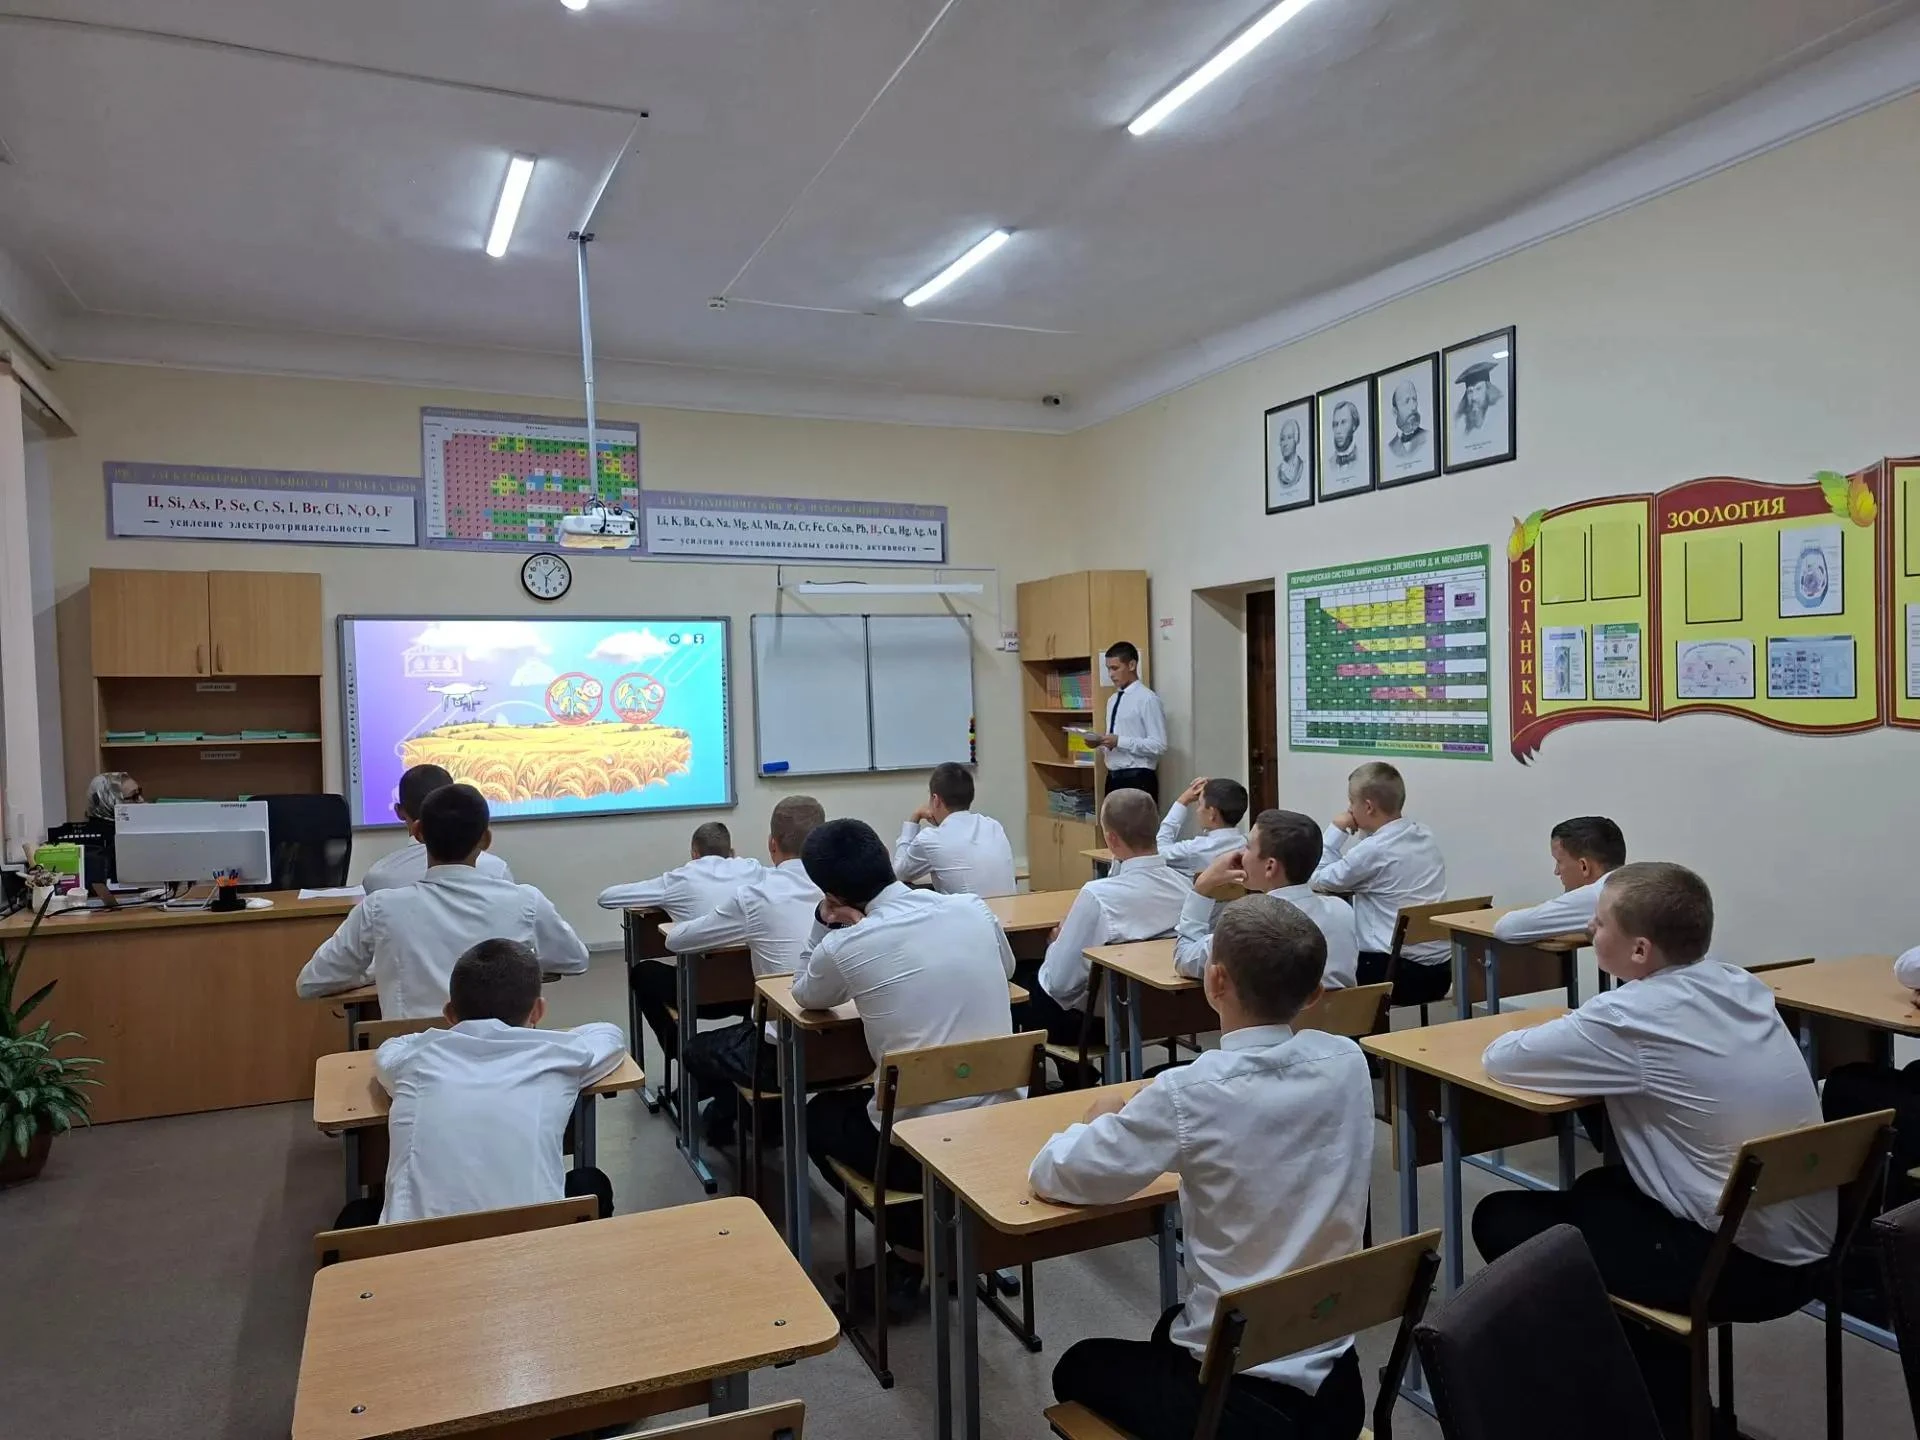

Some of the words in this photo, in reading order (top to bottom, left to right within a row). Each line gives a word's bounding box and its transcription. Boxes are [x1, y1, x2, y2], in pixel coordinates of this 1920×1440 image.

[148, 496, 163, 509] H,
[167, 496, 185, 510] Si,
[188, 498, 210, 511] As,
[215, 499, 226, 512] P,
[230, 500, 249, 512] Se,
[253, 500, 269, 513] C,
[272, 501, 285, 513] S,
[303, 502, 321, 515] Br,
[348, 504, 362, 517] N,
[365, 505, 380, 517] O,
[385, 506, 393, 517] F
[1667, 496, 1786, 529] ЗООЛОГИЯ
[169, 518, 223, 529] усиление
[230, 520, 370, 534] электроотрицательности
[657, 515, 669, 526] Li,
[671, 515, 681, 526] K,
[684, 516, 698, 528] Ba,
[700, 517, 714, 528] Ca,
[717, 518, 731, 528] Na,
[733, 518, 750, 531] Mg,
[765, 519, 780, 531] Mn,
[783, 520, 797, 532] Zn,
[798, 521, 811, 532] Cr,
[813, 522, 825, 533] Fe,
[856, 523, 868, 535] Pb,
[899, 525, 912, 537] Hg,
[680, 537, 724, 547] усиление
[729, 539, 820, 550] восстановительных
[866, 543, 916, 553] активности
[1442, 551, 1483, 565] МЕНДЕЛЕЕВА
[1520, 558, 1533, 715] БОТАНИКА
